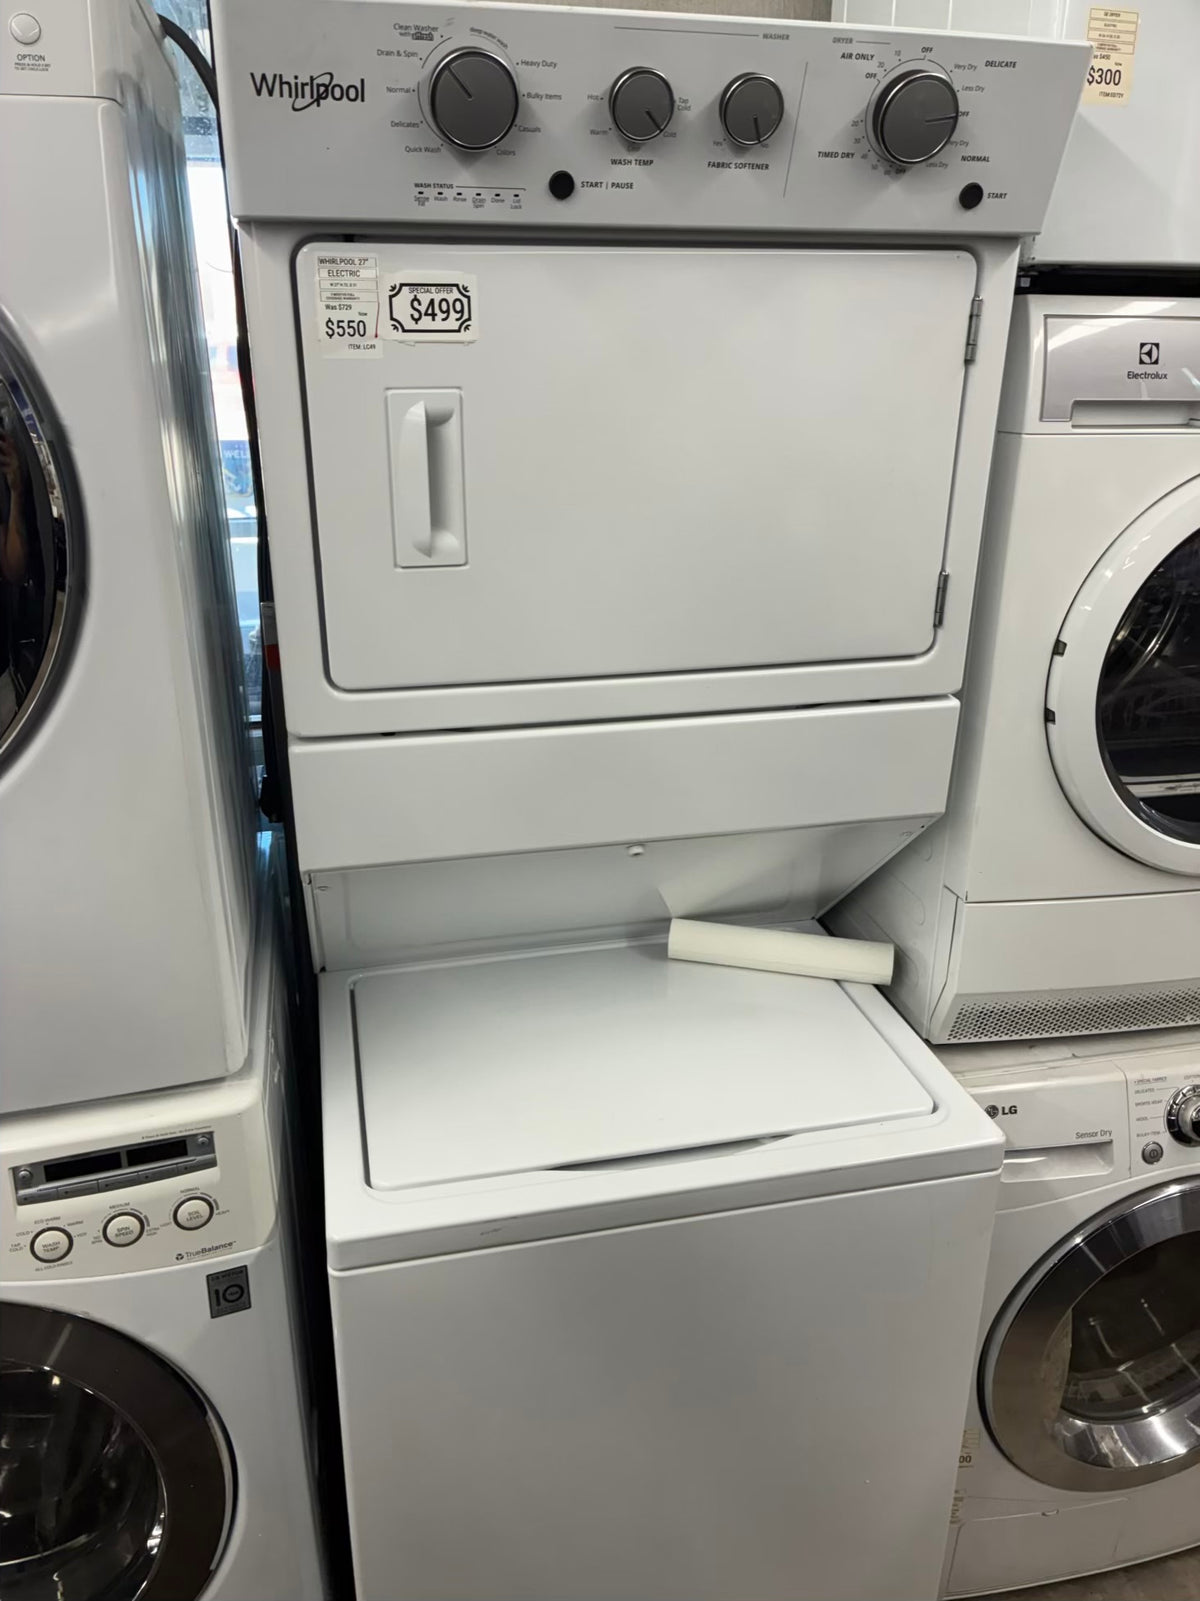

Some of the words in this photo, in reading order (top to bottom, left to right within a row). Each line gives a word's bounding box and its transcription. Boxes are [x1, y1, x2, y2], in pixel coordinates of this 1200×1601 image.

[393, 22, 412, 31] Clean
[413, 24, 439, 33] Washer
[762, 32, 790, 41] WASHER
[832, 36, 854, 45] DRYER
[376, 48, 396, 57] Drain
[396, 49, 402, 57] &
[403, 49, 419, 59] Spin
[921, 46, 934, 54] OFF
[16, 53, 46, 62] OPTION
[840, 52, 854, 60] AIR
[854, 53, 876, 61] ONLY
[520, 59, 541, 69] Heavy
[541, 60, 558, 69] Duty
[953, 63, 967, 72] Very
[966, 63, 978, 72] Dry
[984, 60, 1018, 69] DELICATE
[864, 72, 878, 80] OFF
[1086, 65, 1122, 86] $300
[249, 71, 366, 112] Whirlpool
[385, 85, 412, 94] Normal
[961, 84, 975, 93] Less
[974, 85, 986, 93] Dry
[526, 91, 544, 101] Bulky
[544, 93, 563, 101] Items
[587, 94, 600, 102] Hot
[677, 104, 692, 112] Cold
[390, 120, 420, 129] Delicates
[517, 124, 542, 134] Casuals
[590, 128, 608, 136] Warm
[663, 130, 678, 138] Cold
[404, 144, 423, 153] Quick
[423, 145, 442, 154] Wash
[817, 151, 839, 159] TIMED
[960, 154, 991, 163] NORMAL
[610, 158, 633, 167] WASH
[633, 159, 654, 167] TEMP
[707, 160, 733, 170] FABRIC
[733, 162, 770, 171] SOFTENER
[580, 180, 604, 190] START
[610, 182, 635, 190] PAUSE
[986, 191, 1008, 200] START
[319, 258, 357, 266] WHIRLPOOL
[327, 269, 361, 278] ELECTRIC
[434, 287, 454, 295] OFFER
[338, 303, 353, 311] $729
[410, 294, 465, 325] $499
[325, 317, 366, 339] $550
[1127, 371, 1168, 380] Electrolux
[1001, 1105, 1018, 1116] LG
[1075, 1130, 1099, 1140] Sensor
[1099, 1129, 1113, 1138] Dry
[186, 1214, 203, 1222] LEVEL
[42, 1241, 61, 1249] WASH
